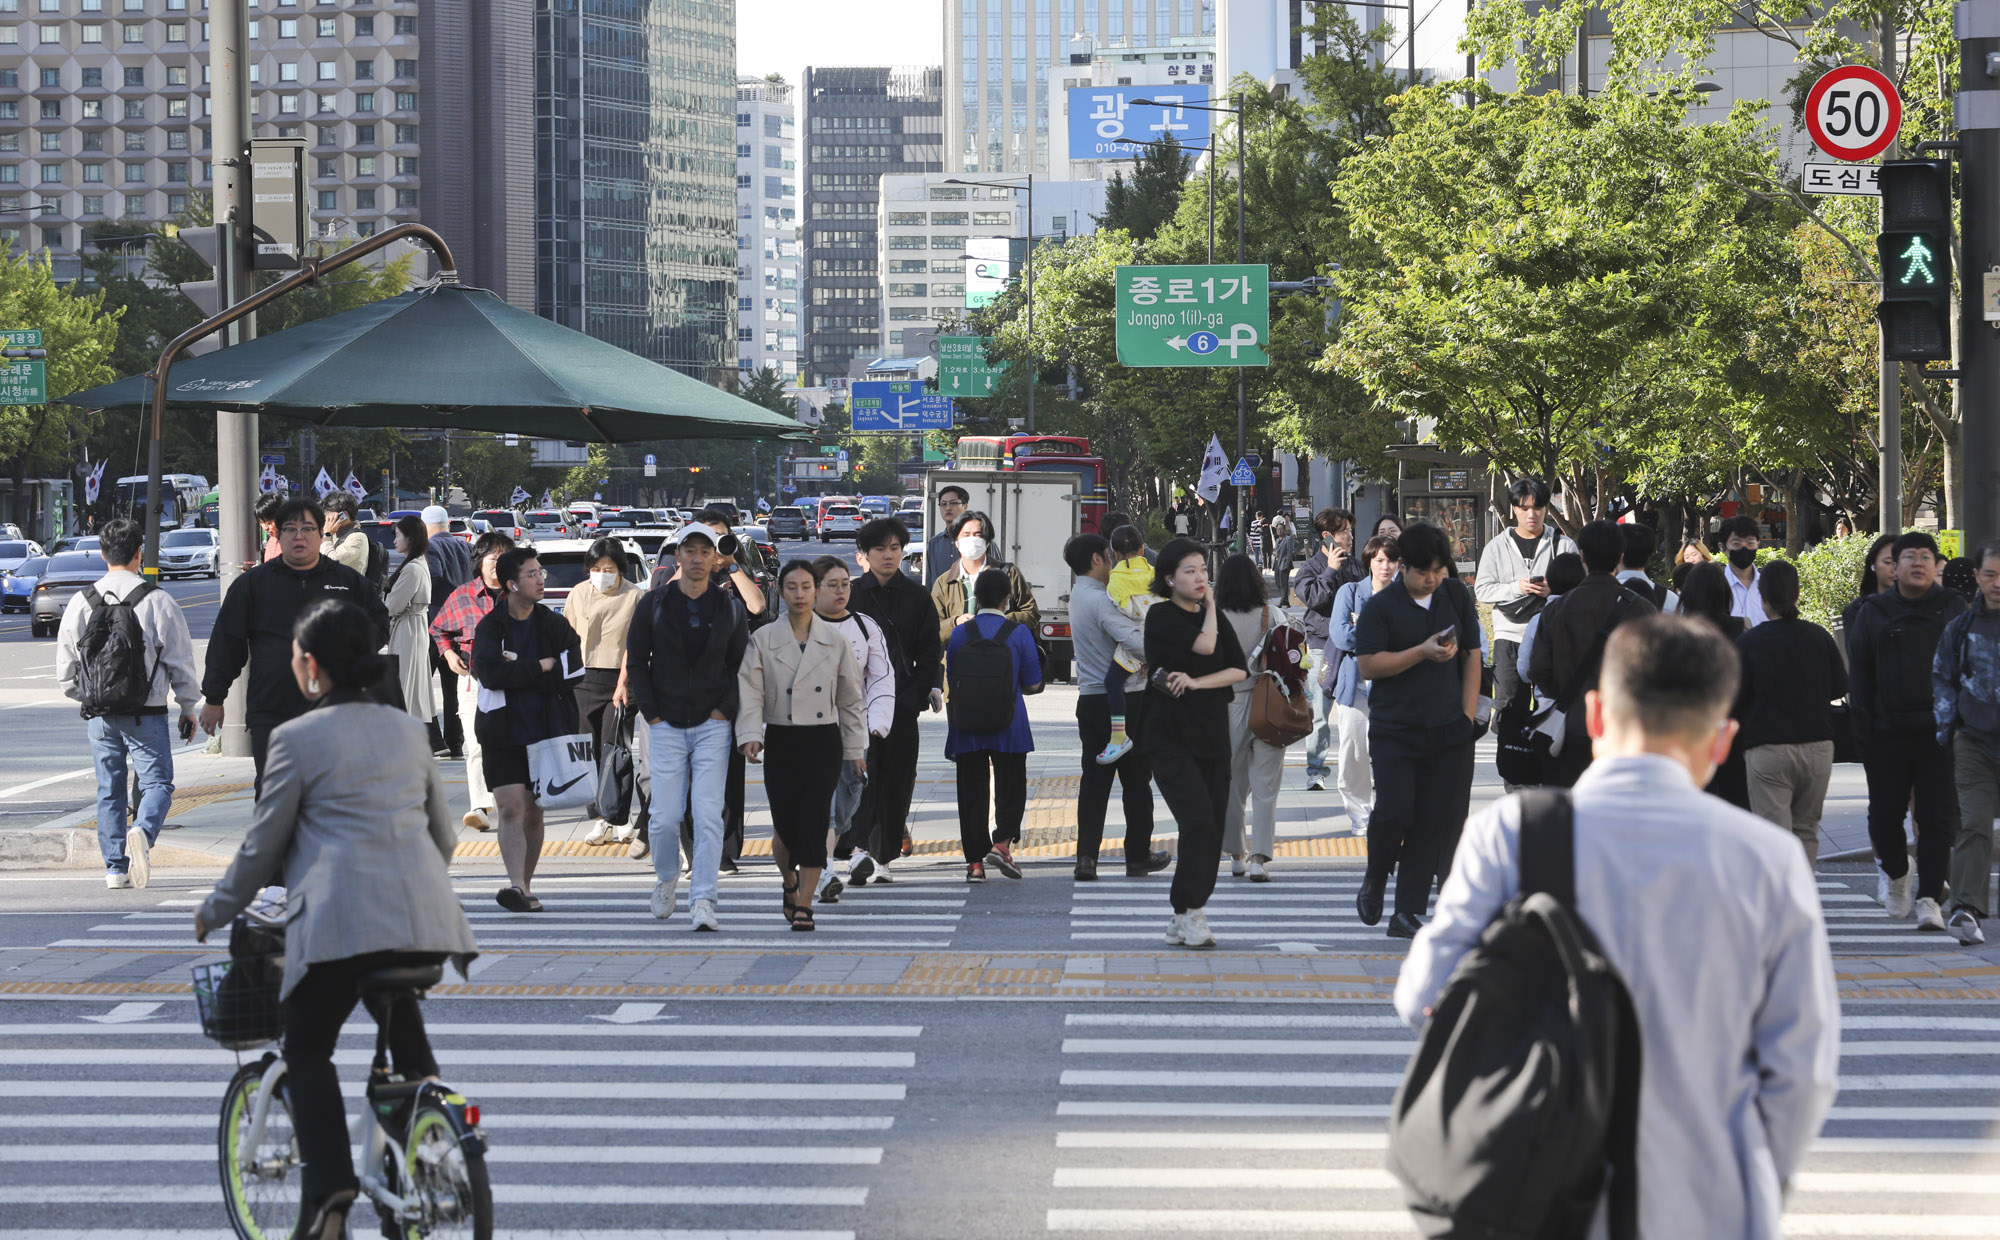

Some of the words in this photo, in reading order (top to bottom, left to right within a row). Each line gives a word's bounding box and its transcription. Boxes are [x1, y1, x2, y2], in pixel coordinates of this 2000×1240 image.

[1089, 93, 1189, 139] 광고
[1825, 91, 1881, 137] 50
[1128, 275, 1253, 306] 종로1가
[1127, 309, 1176, 330] Jongno
[1180, 309, 1224, 330] 1(il)-ga
[0, 333, 36, 344] 계광장
[1197, 335, 1209, 352] 6
[941, 344, 972, 353] 남산3호터널
[0, 386, 21, 397] 시청
[891, 384, 910, 392] 서울역
[1, 396, 13, 404] City
